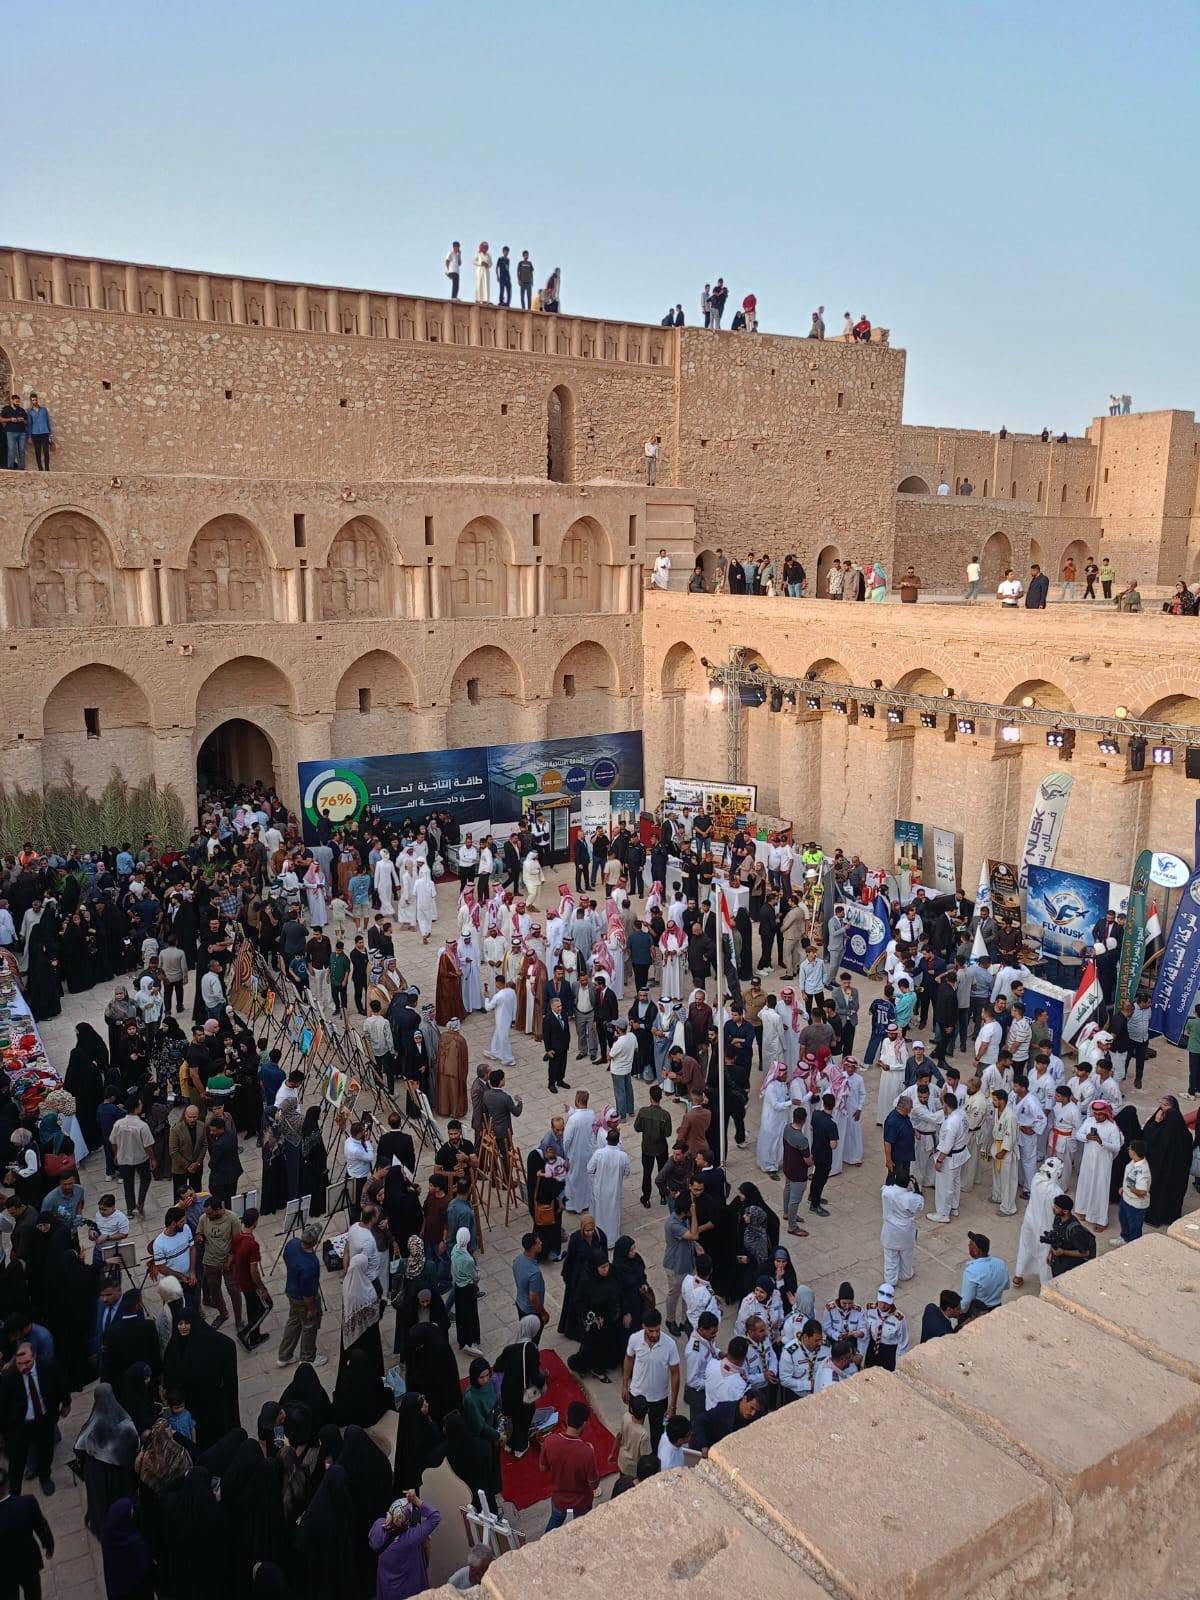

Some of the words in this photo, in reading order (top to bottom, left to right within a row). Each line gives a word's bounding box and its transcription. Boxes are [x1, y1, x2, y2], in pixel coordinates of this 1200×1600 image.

[454, 776, 483, 788] طاقة
[320, 793, 352, 808] 76%
[1025, 807, 1046, 857] NUSK
[1042, 921, 1057, 932] FLY
[1058, 927, 1085, 940] NUSK
[877, 1009, 889, 1025] 10
